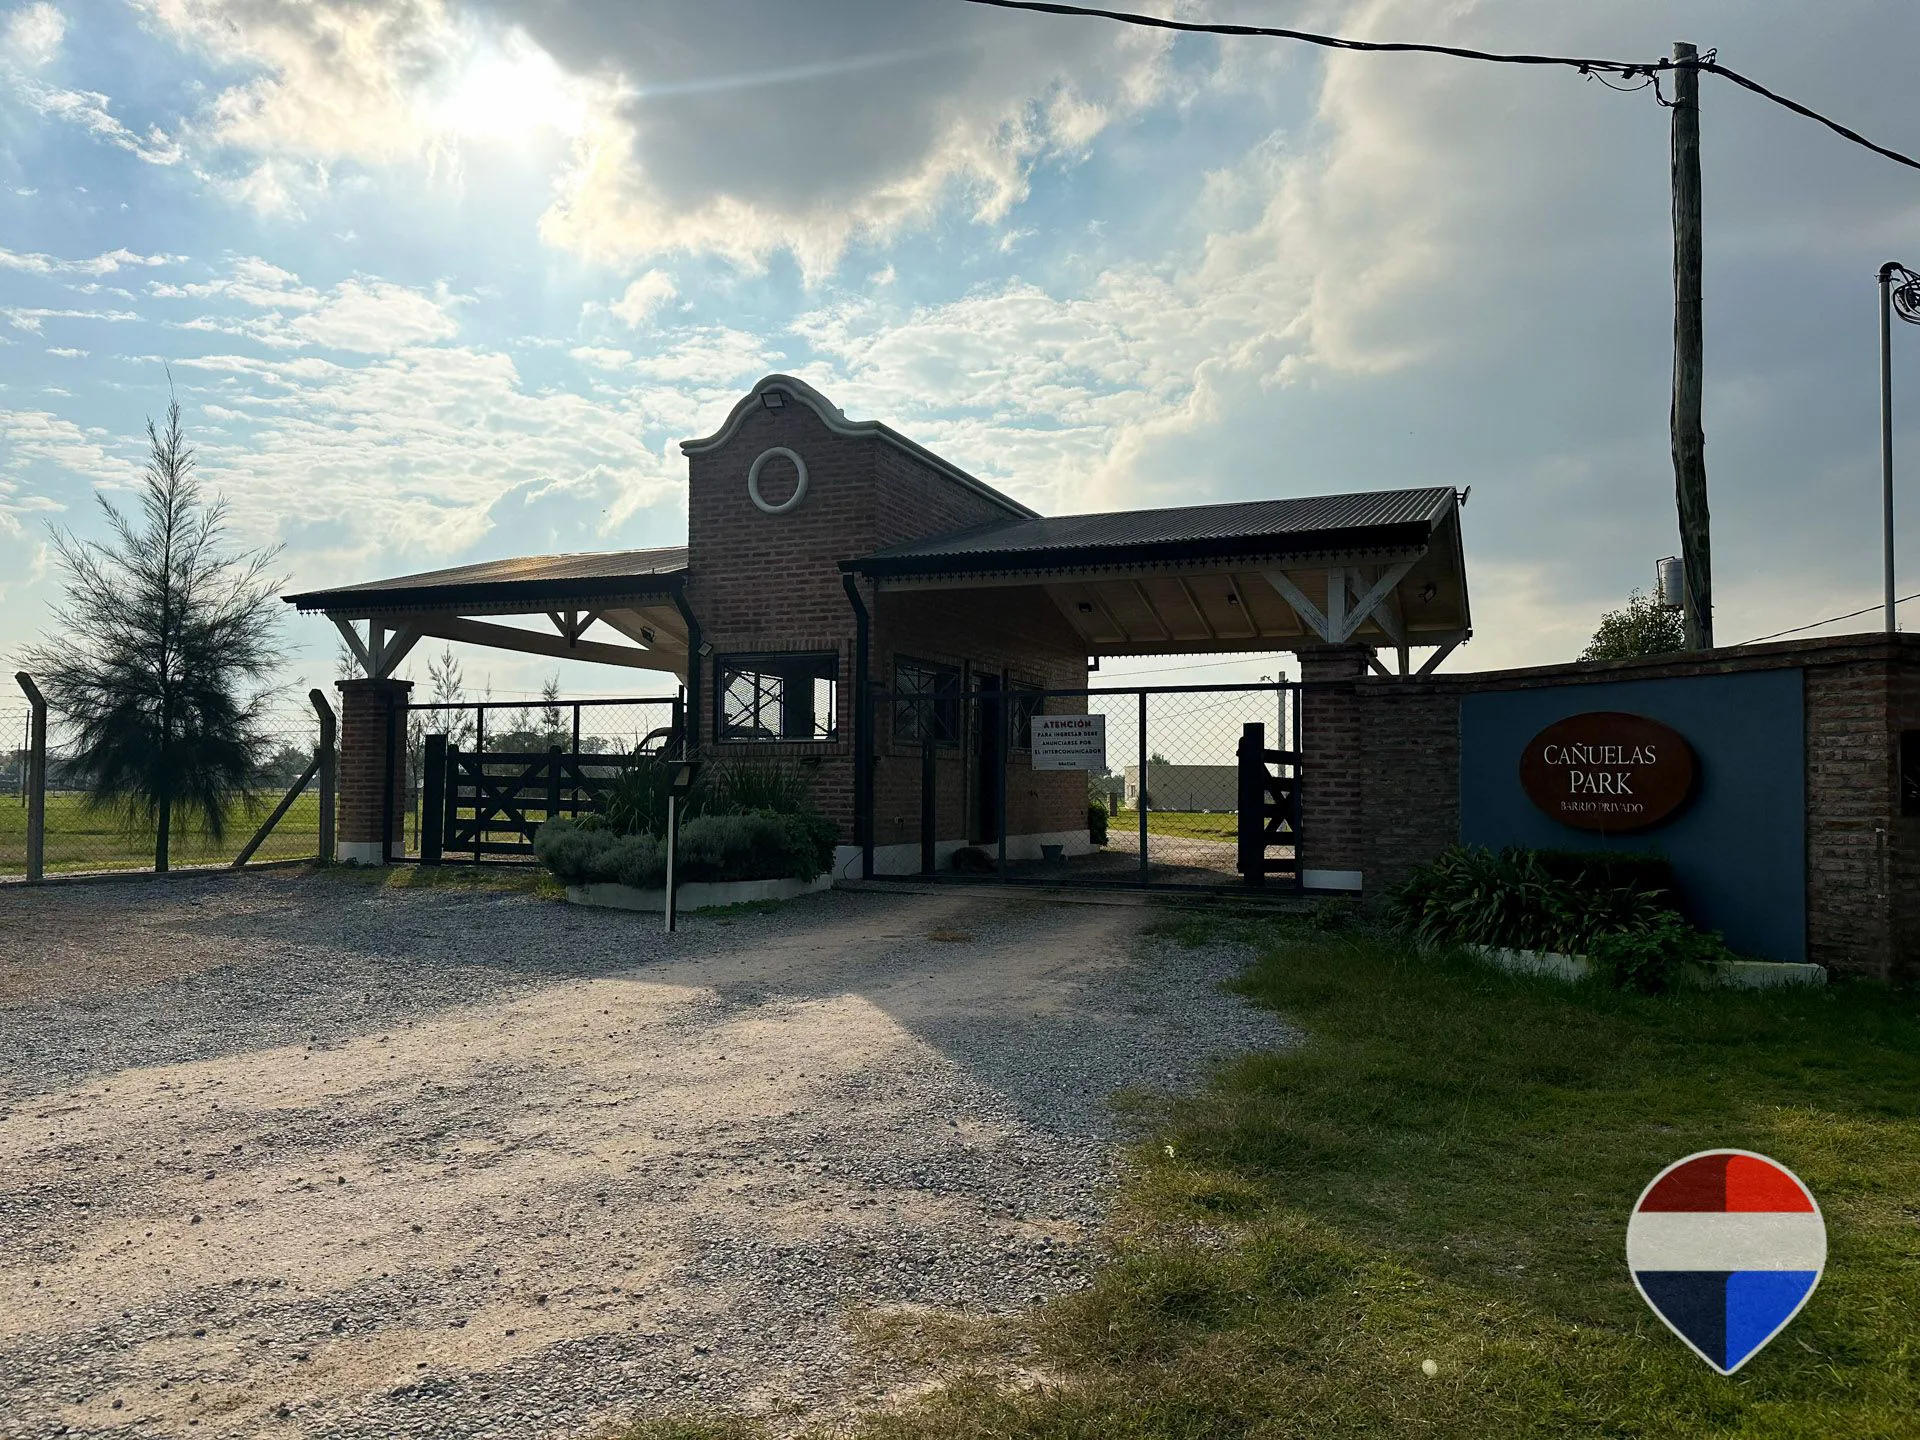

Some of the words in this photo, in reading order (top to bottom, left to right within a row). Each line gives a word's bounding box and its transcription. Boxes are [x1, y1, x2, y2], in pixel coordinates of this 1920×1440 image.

[1043, 719, 1091, 729] ATENCIÓN
[1543, 742, 1656, 765] CAÑUELAS
[1569, 770, 1633, 795] PARK
[1560, 801, 1597, 812] BARRIO
[1598, 801, 1644, 814] PRIVADO
